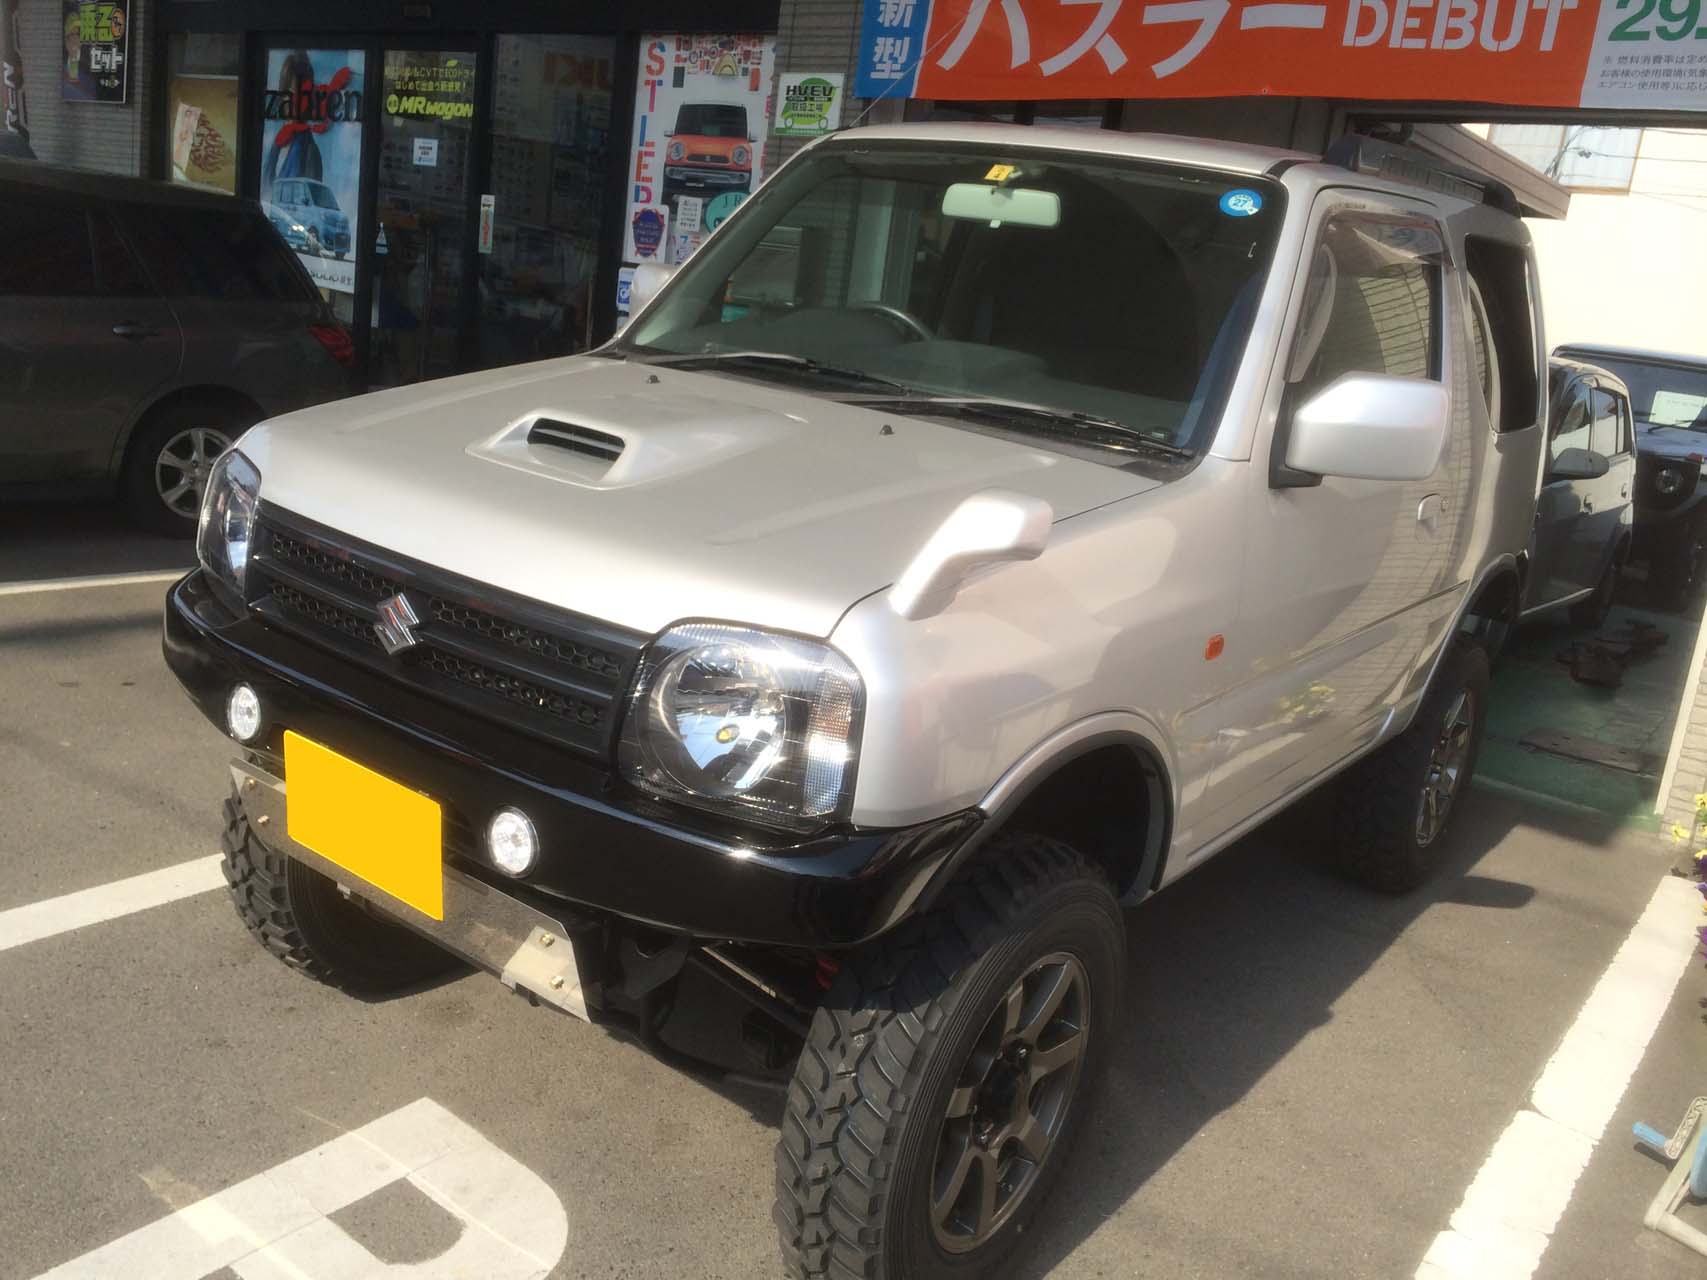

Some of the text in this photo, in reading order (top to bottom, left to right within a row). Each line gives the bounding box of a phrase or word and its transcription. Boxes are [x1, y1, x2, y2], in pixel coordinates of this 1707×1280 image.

[935, 0, 1327, 80] ハスラー
[1342, 0, 1579, 52] DEBUT
[90, 47, 123, 71] セット
